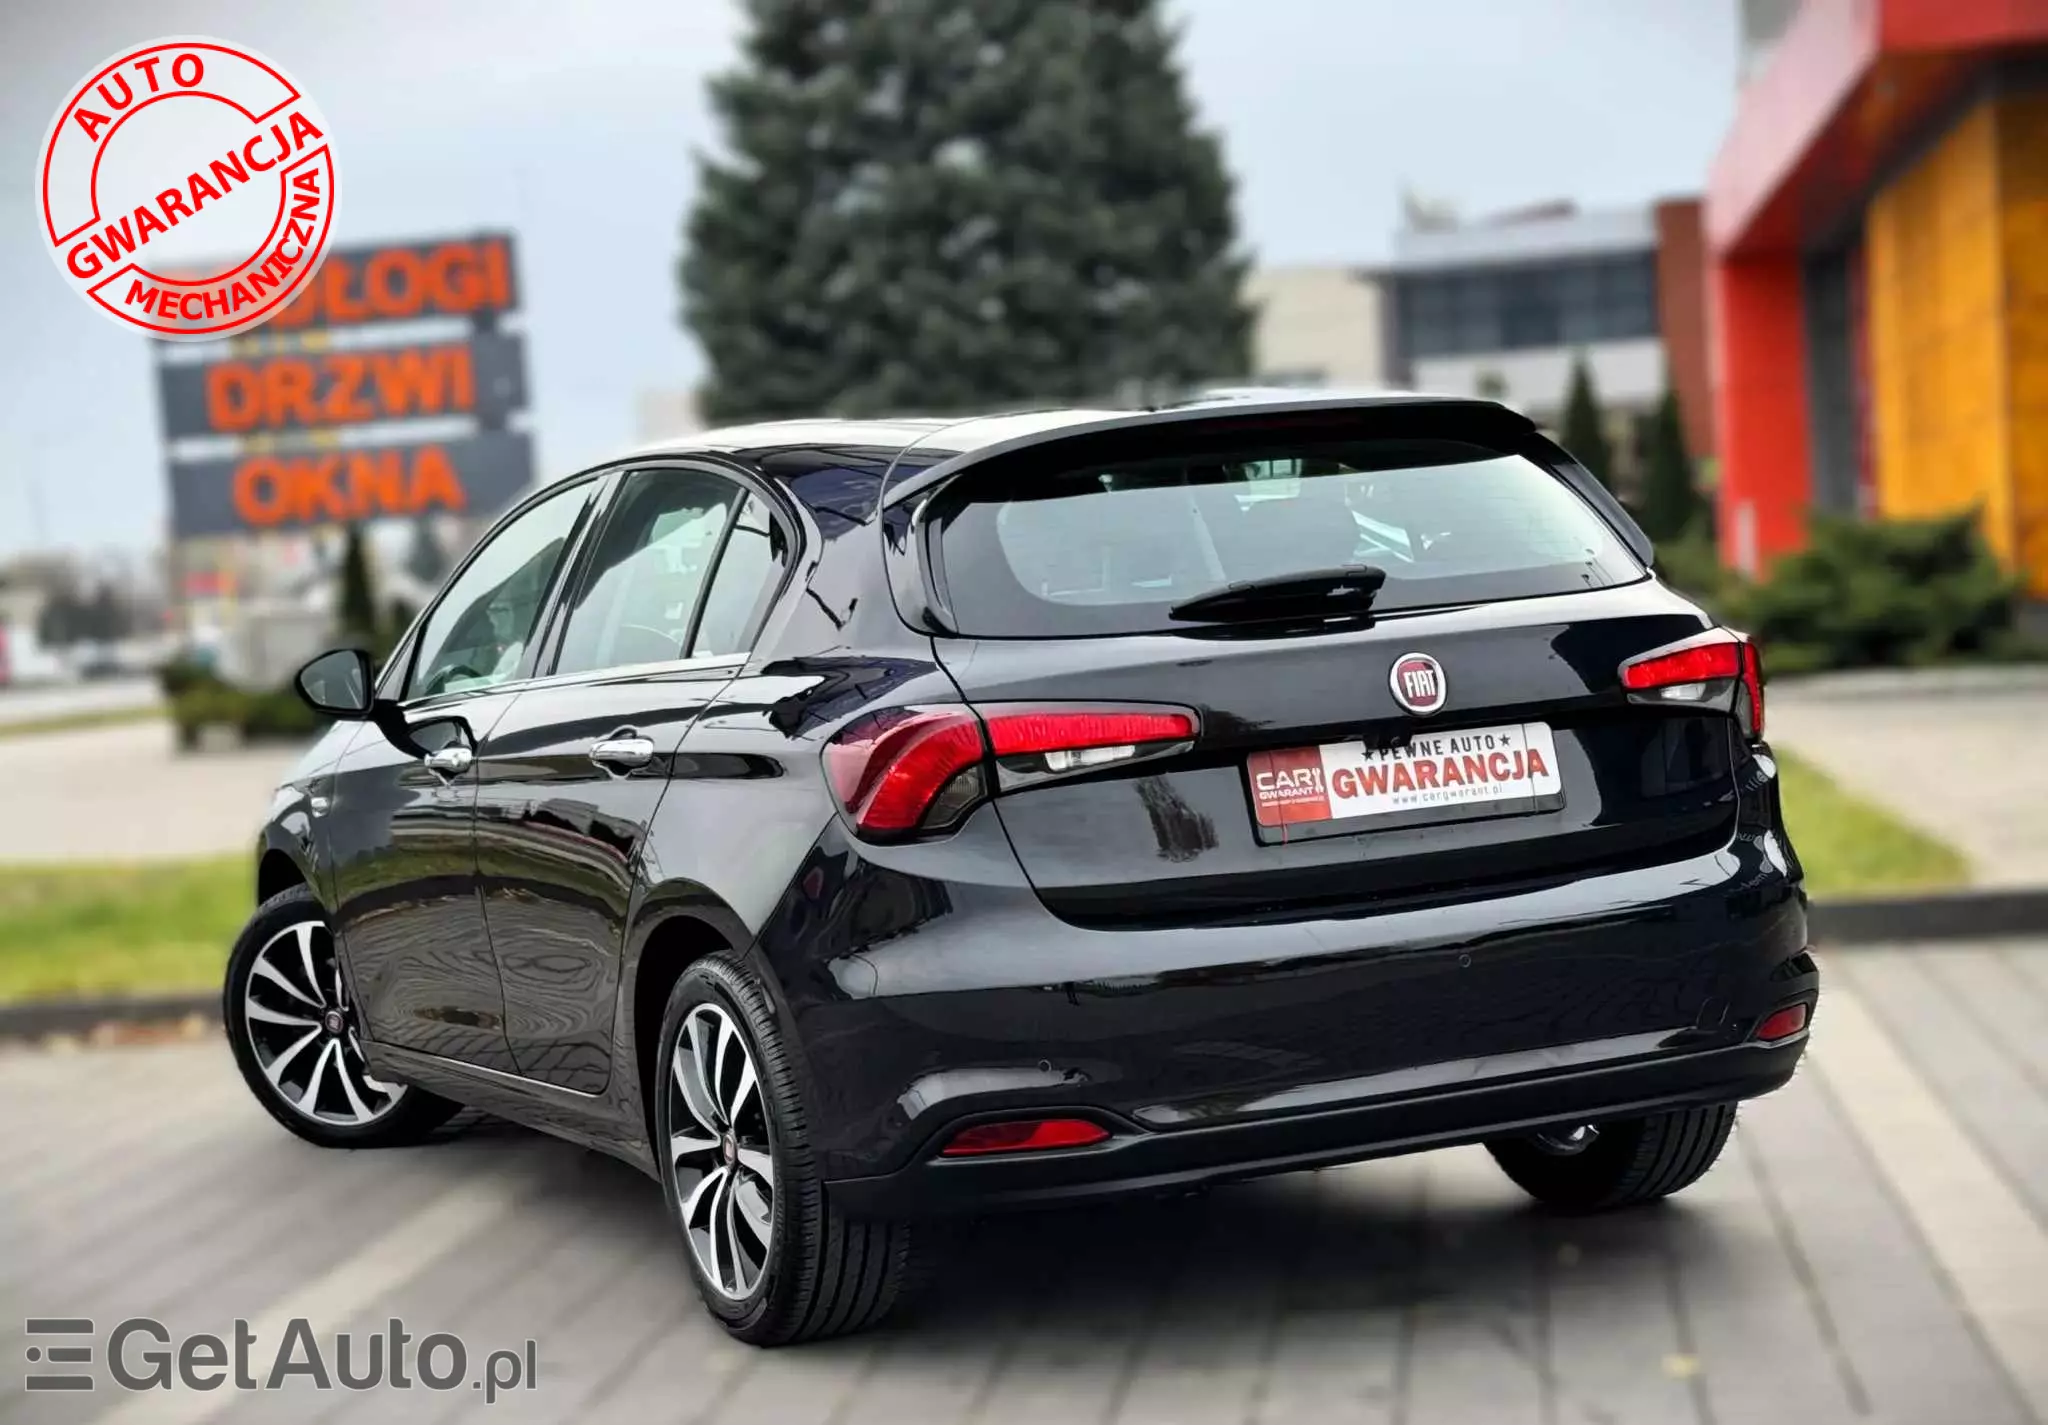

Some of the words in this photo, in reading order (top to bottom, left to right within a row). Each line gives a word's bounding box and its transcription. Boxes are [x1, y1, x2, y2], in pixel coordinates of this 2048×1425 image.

[205, 343, 476, 433] DRZWI
[231, 443, 467, 526] OKNA
[1403, 669, 1438, 698] FIAT
[1379, 739, 1444, 761] PEWNE
[1450, 734, 1496, 755] AUTO
[1256, 768, 1313, 790] CAR
[1332, 748, 1550, 800] GWARANCJA
